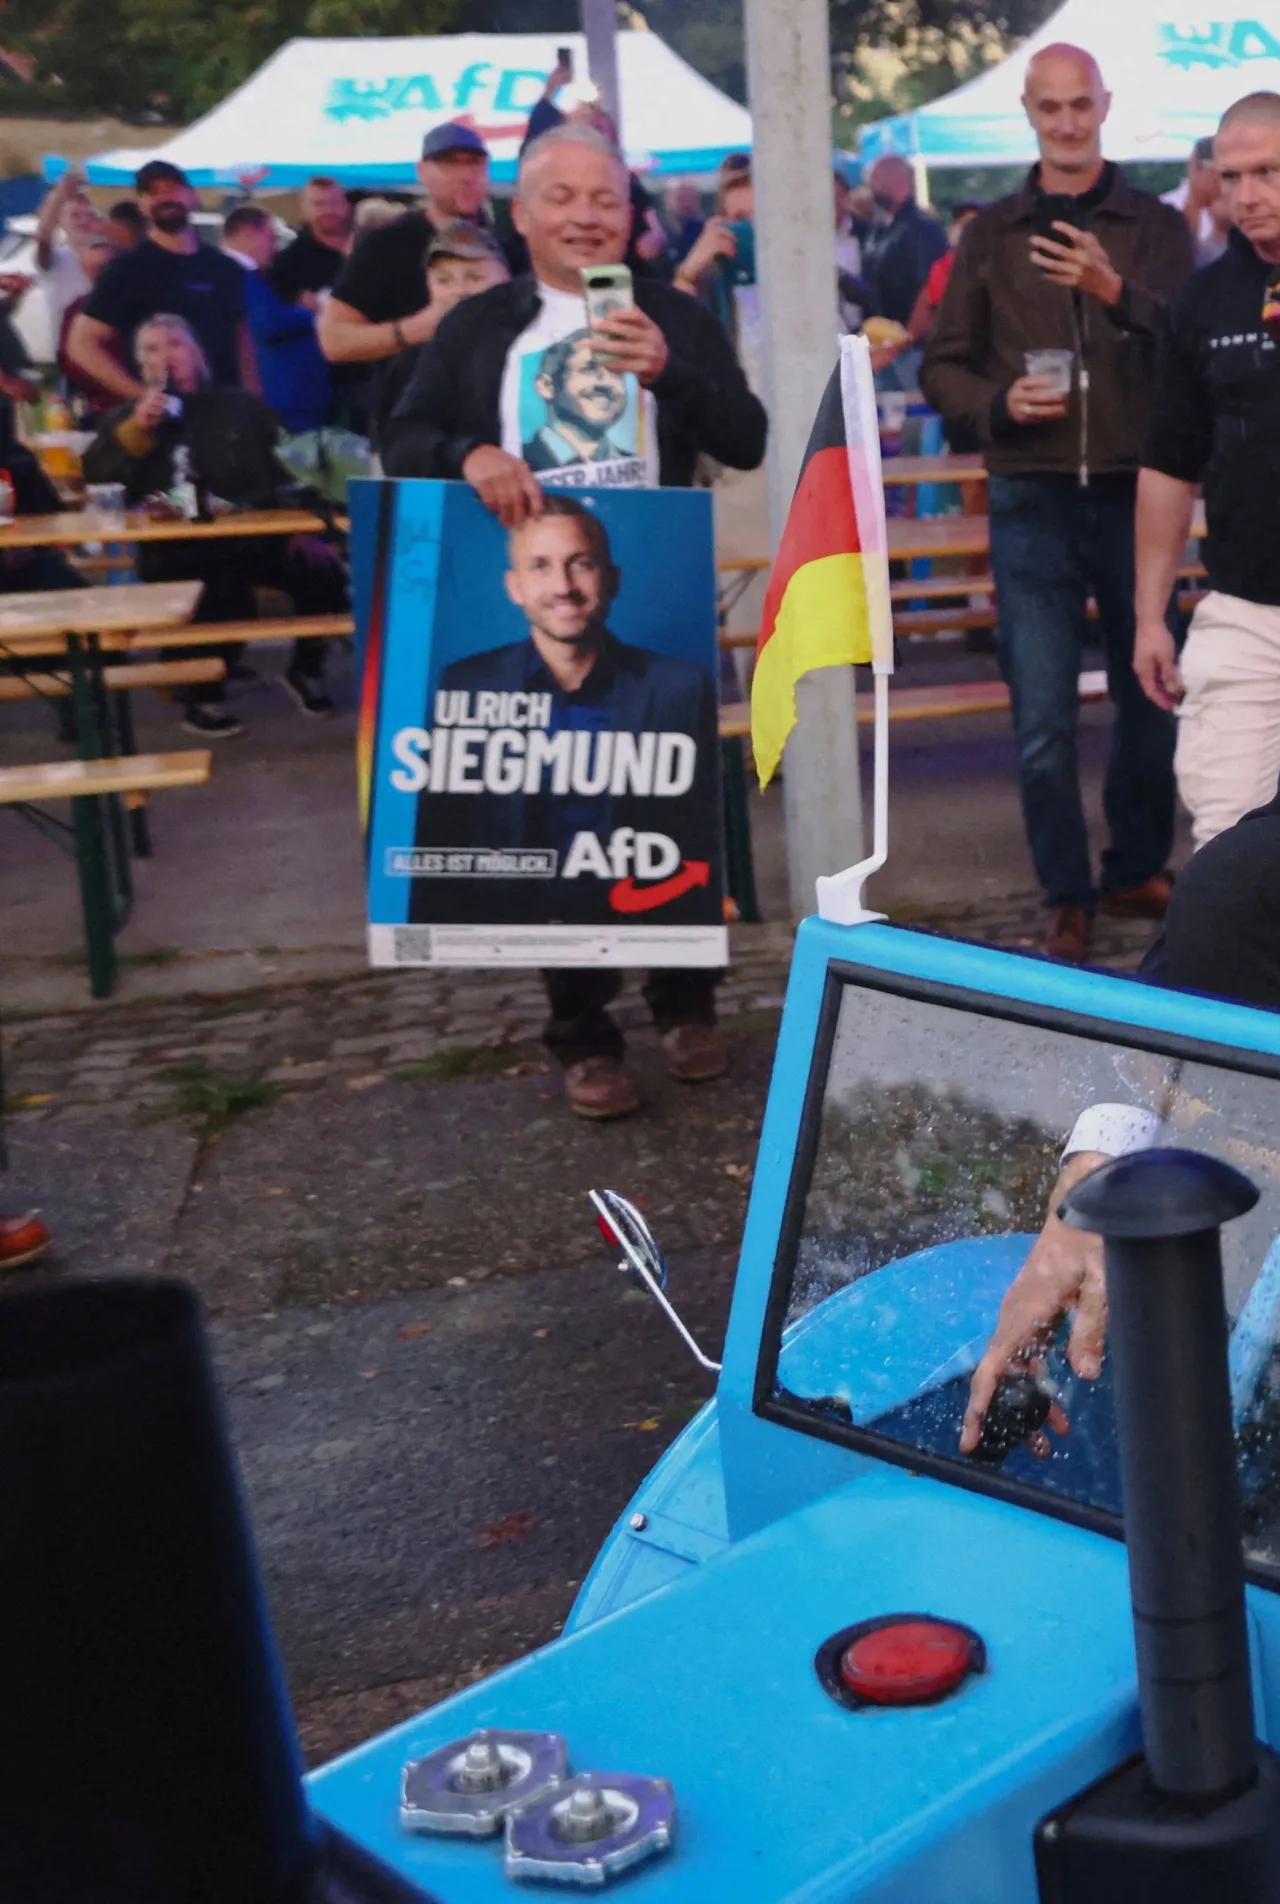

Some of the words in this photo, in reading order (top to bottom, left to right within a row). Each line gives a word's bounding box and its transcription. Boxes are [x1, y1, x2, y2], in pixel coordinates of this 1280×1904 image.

[389, 62, 552, 112] AfD
[434, 689, 552, 729] ULRICH
[389, 727, 698, 797] SIEGMUND
[393, 854, 445, 871] ALLES
[446, 854, 474, 872] IST
[562, 826, 682, 880] AfD
